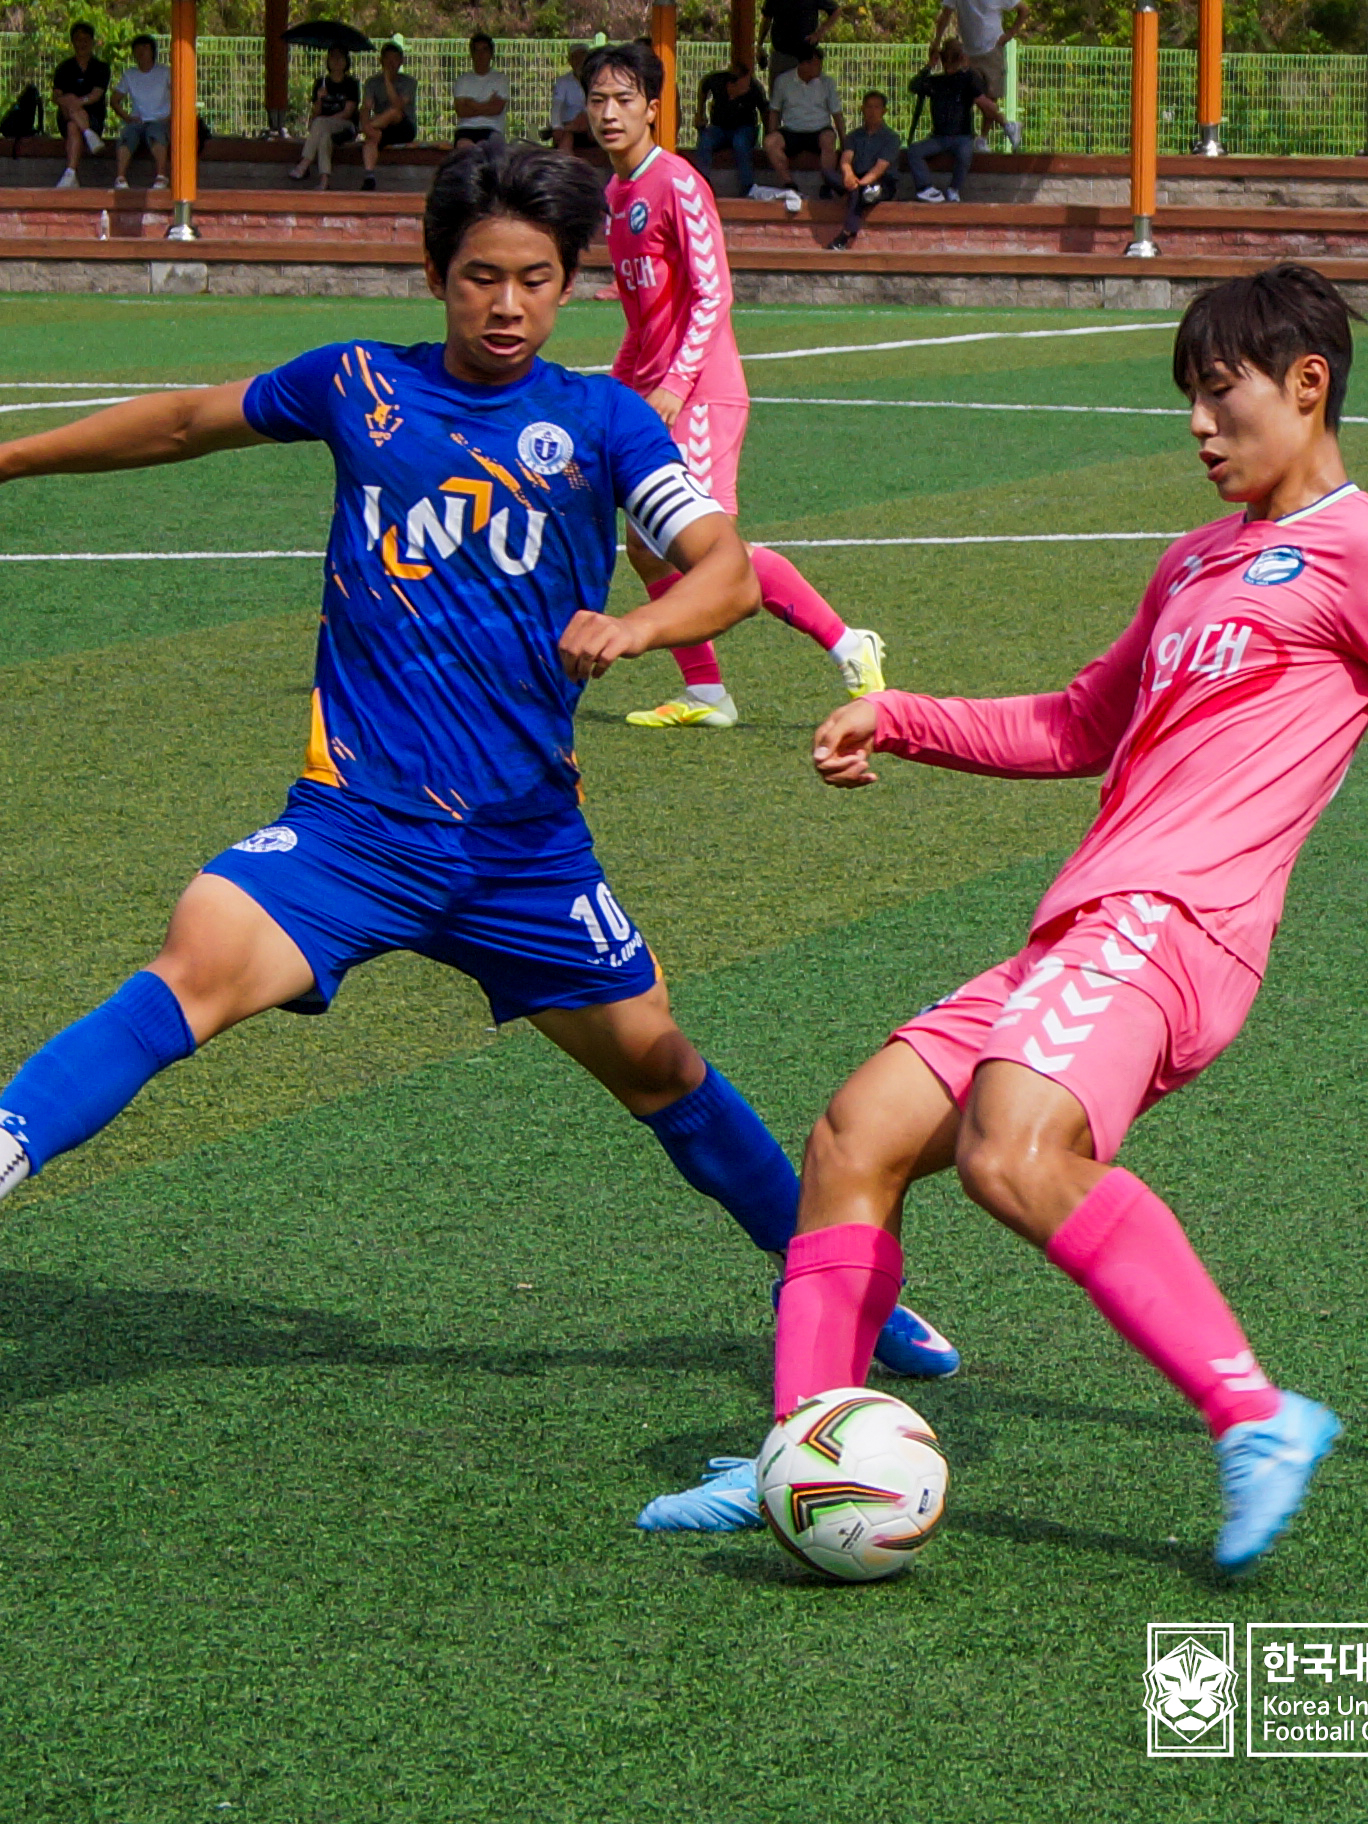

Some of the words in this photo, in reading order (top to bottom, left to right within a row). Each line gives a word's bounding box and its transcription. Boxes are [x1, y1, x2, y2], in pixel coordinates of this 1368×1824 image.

[611, 254, 657, 291] 인대
[1141, 621, 1253, 692] 인대
[569, 881, 631, 954] 10
